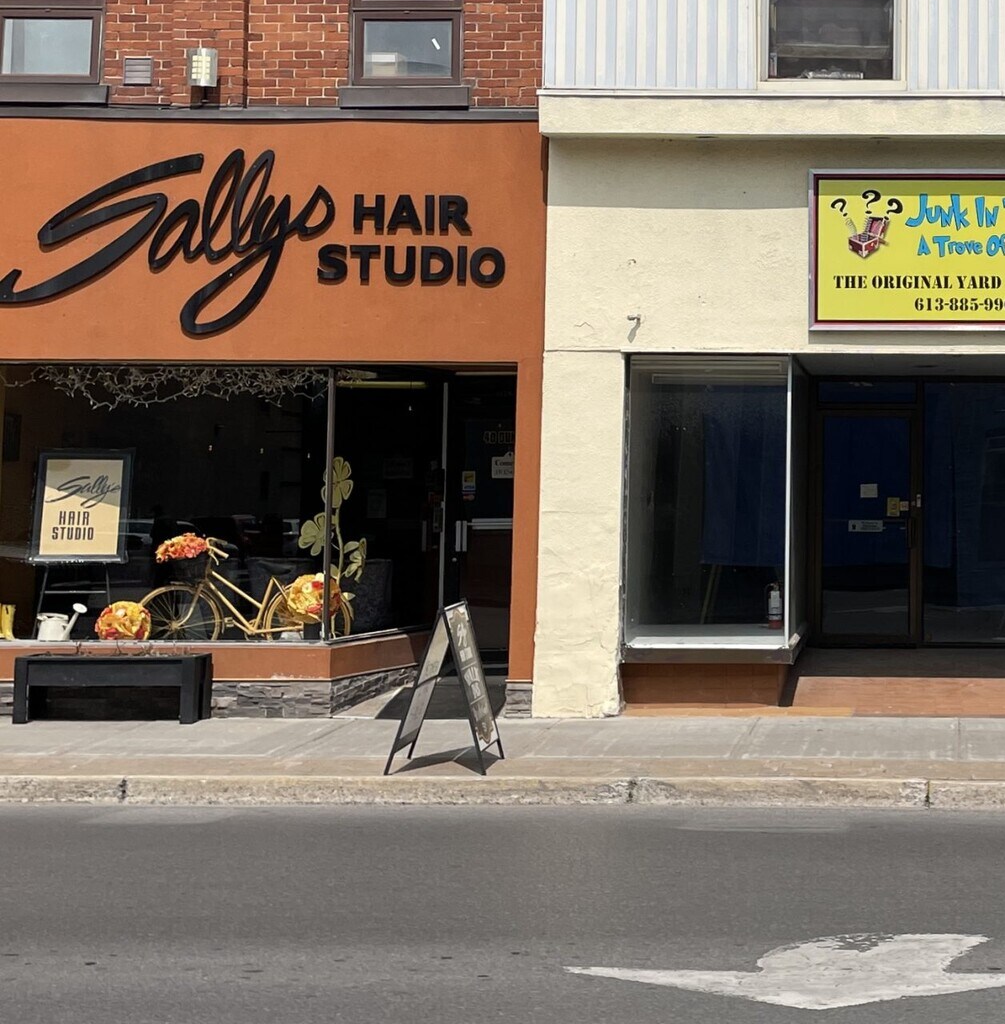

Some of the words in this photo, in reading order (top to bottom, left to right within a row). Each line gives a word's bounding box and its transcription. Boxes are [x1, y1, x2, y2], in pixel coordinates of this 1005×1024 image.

[353, 193, 472, 235] HAIR
[917, 234, 931, 256] A
[932, 235, 983, 257] Trove
[317, 245, 506, 286] STUDIO
[833, 275, 868, 290] THE
[871, 275, 953, 290] ORIGINAL
[957, 275, 1001, 290] YARD
[59, 511, 90, 526] HAIR
[52, 526, 95, 541] STUDIO
